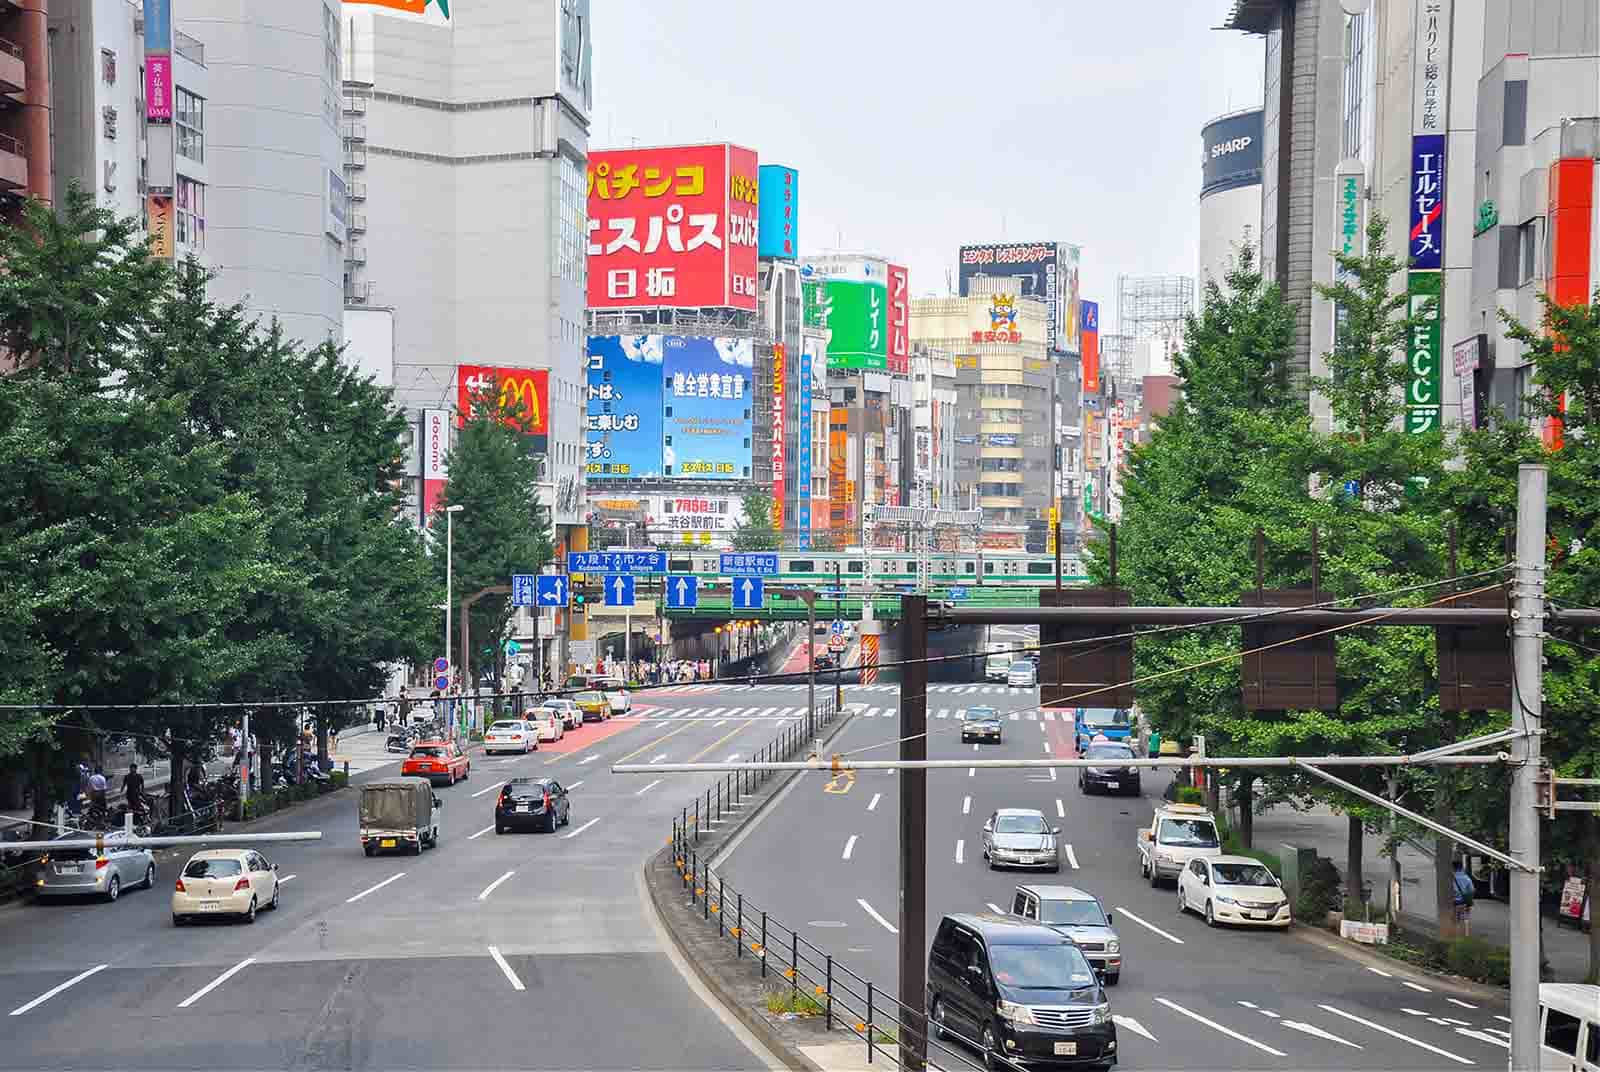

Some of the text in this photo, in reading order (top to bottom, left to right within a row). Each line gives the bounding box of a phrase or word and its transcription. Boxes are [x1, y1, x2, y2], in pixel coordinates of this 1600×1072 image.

[1211, 136, 1252, 158] SHARP
[607, 267, 676, 298] 日拓
[869, 287, 880, 349] レイク
[893, 271, 905, 355] アコム
[431, 415, 441, 472] docomo
[576, 554, 612, 565] 九段下
